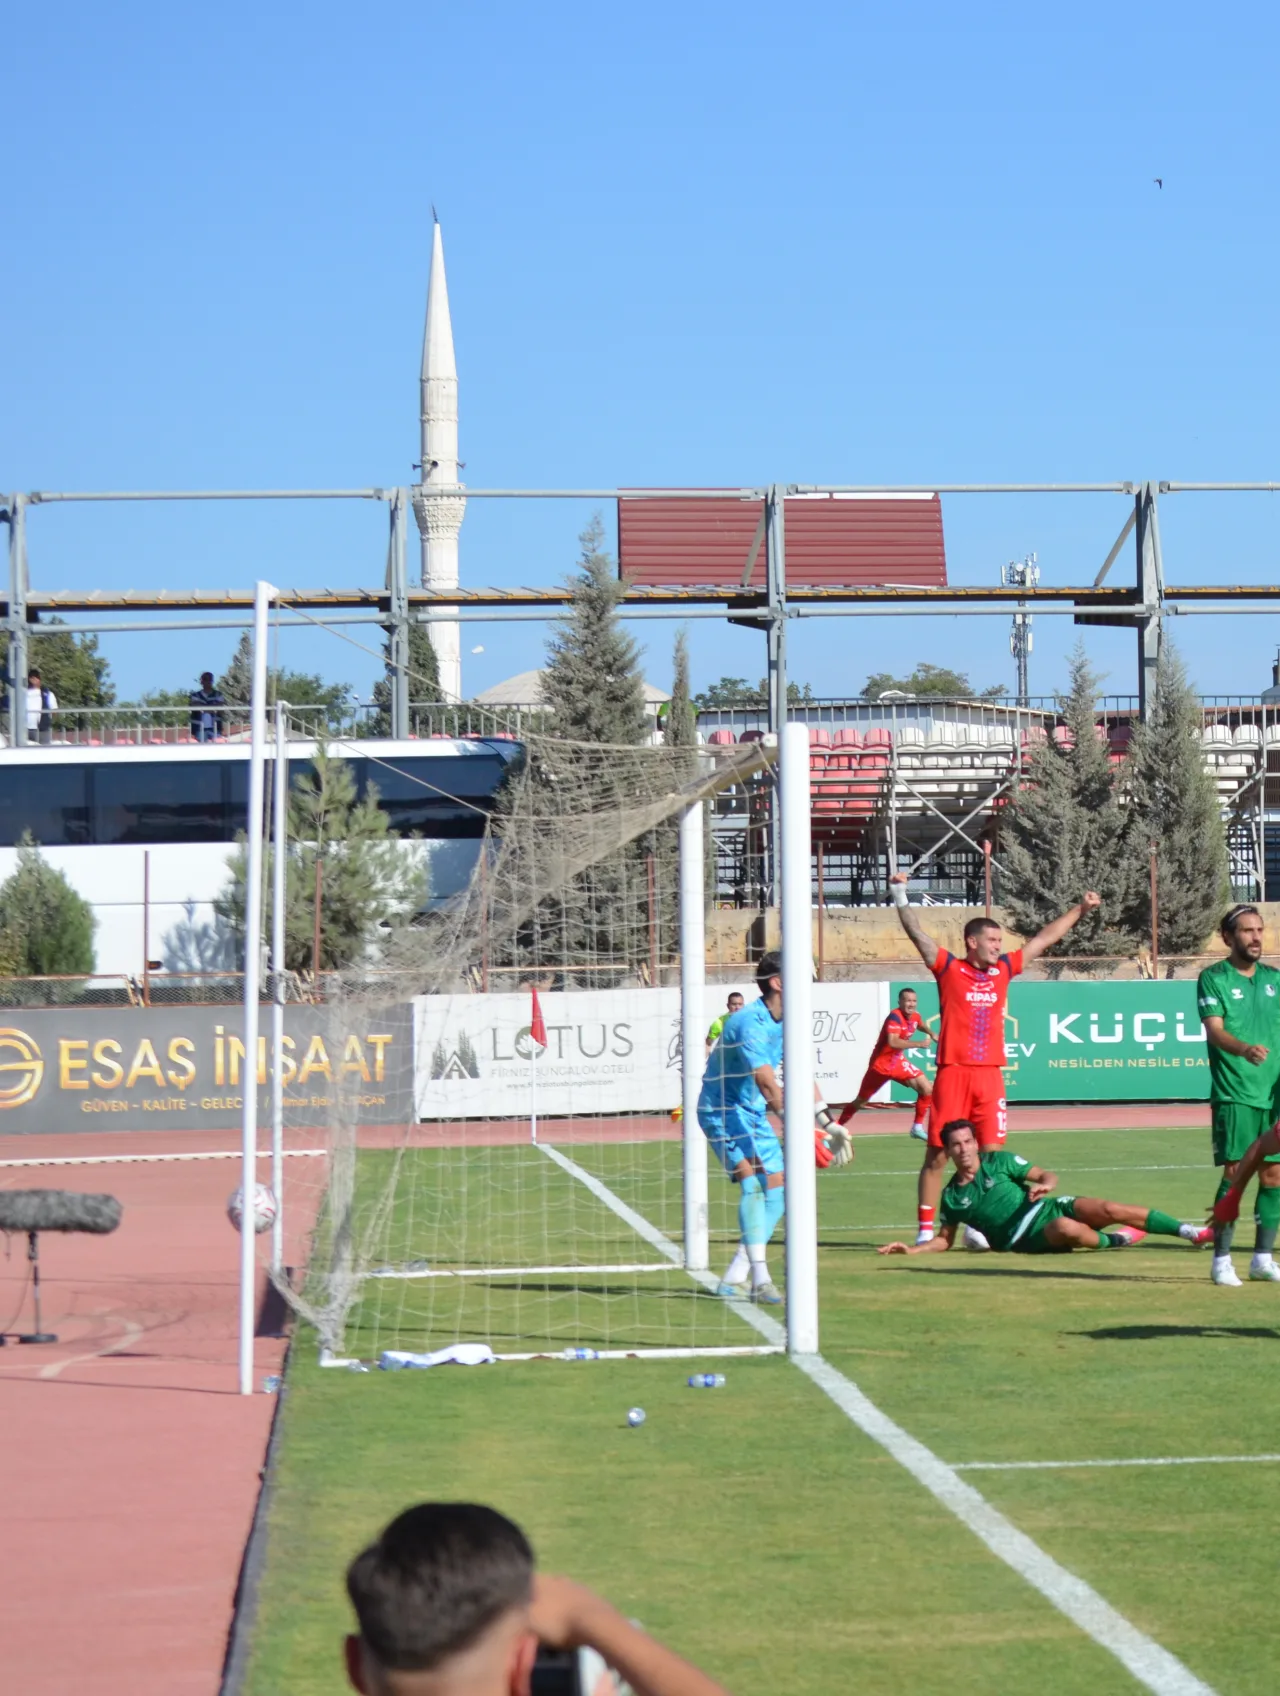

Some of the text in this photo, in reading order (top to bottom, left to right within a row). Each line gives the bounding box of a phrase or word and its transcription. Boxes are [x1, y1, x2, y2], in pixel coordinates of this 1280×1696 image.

[491, 1023, 634, 1061] LOTUS
[58, 1037, 197, 1091] ESAŞ
[1049, 1056, 1124, 1068] NESİLDEN
[1127, 1056, 1181, 1067] NESİLE
[82, 1099, 128, 1112] GÜVEN
[142, 1097, 187, 1111] KALİTE
